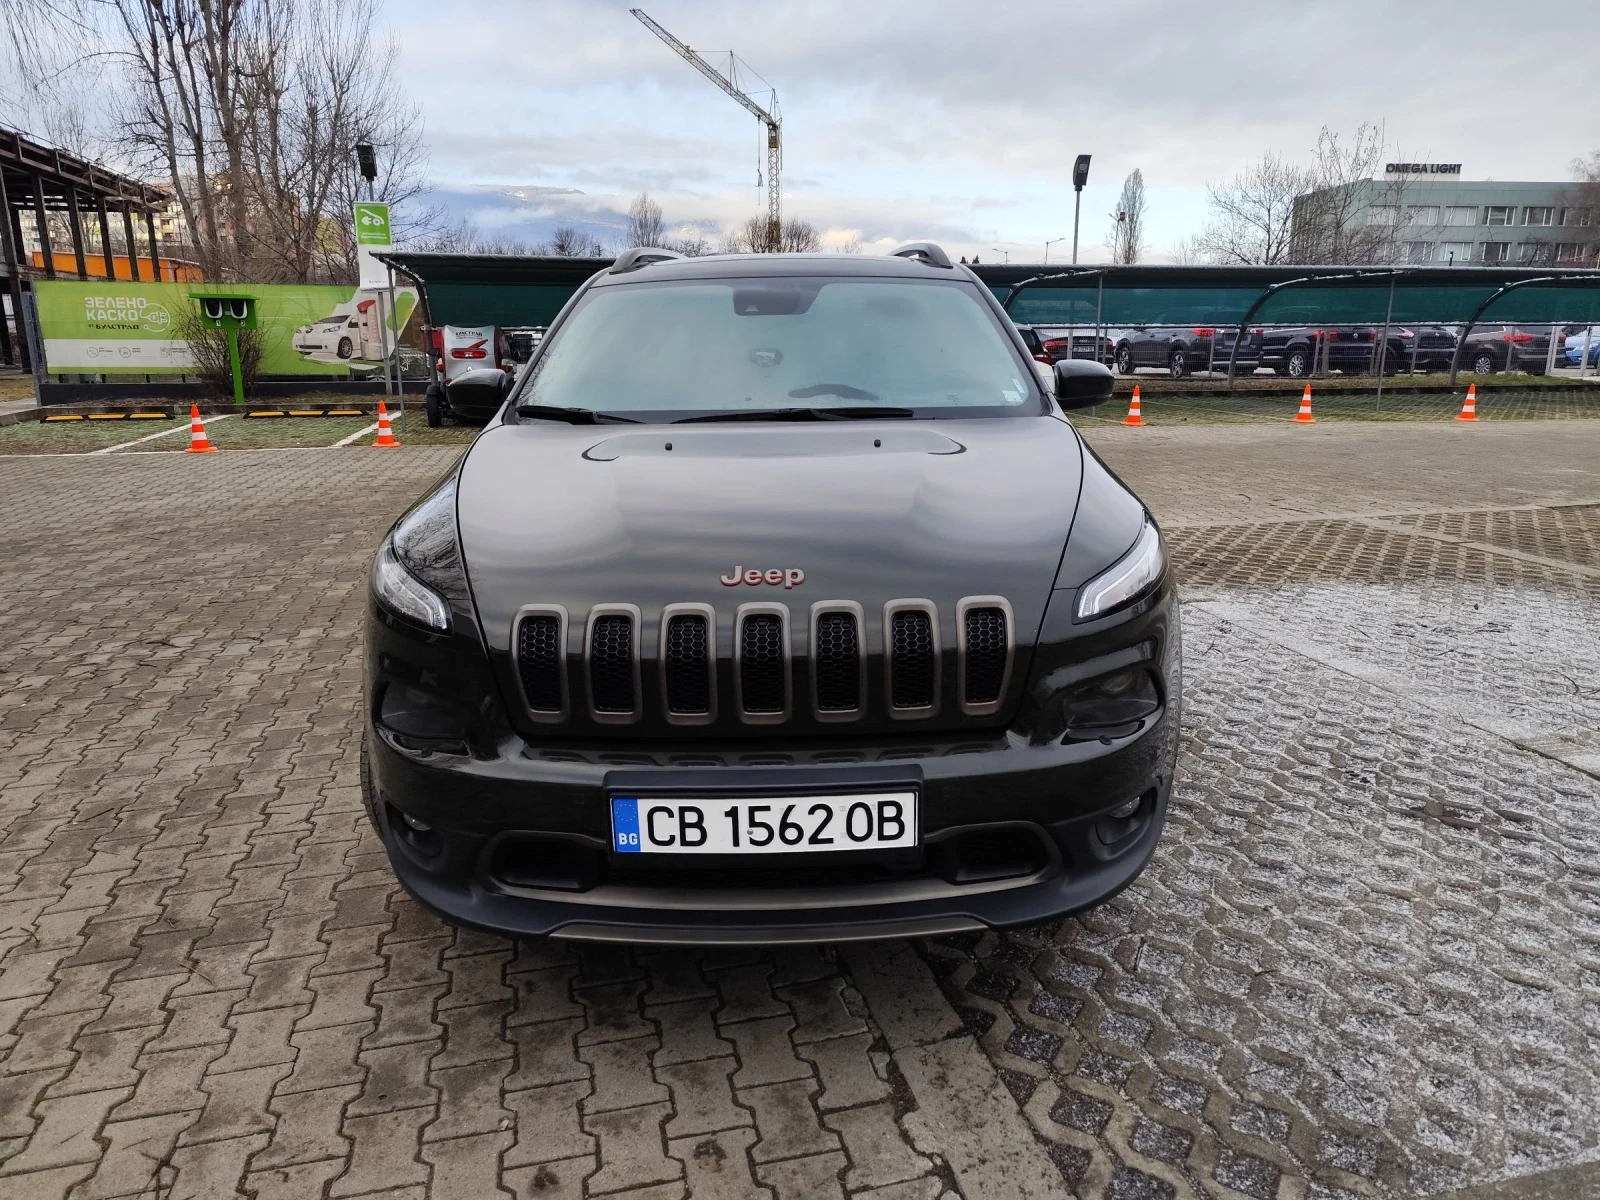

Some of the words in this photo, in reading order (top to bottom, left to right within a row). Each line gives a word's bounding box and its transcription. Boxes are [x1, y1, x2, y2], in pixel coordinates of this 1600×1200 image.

[1385, 163, 1428, 174] OMEGA
[1430, 163, 1462, 174] LIGHT
[84, 297, 147, 309] ЗЕЛЕНО
[86, 309, 138, 321] КАСКО
[720, 565, 805, 589] Jeep
[647, 805, 707, 847] CB
[724, 803, 834, 847] 1562
[618, 832, 638, 845] BG
